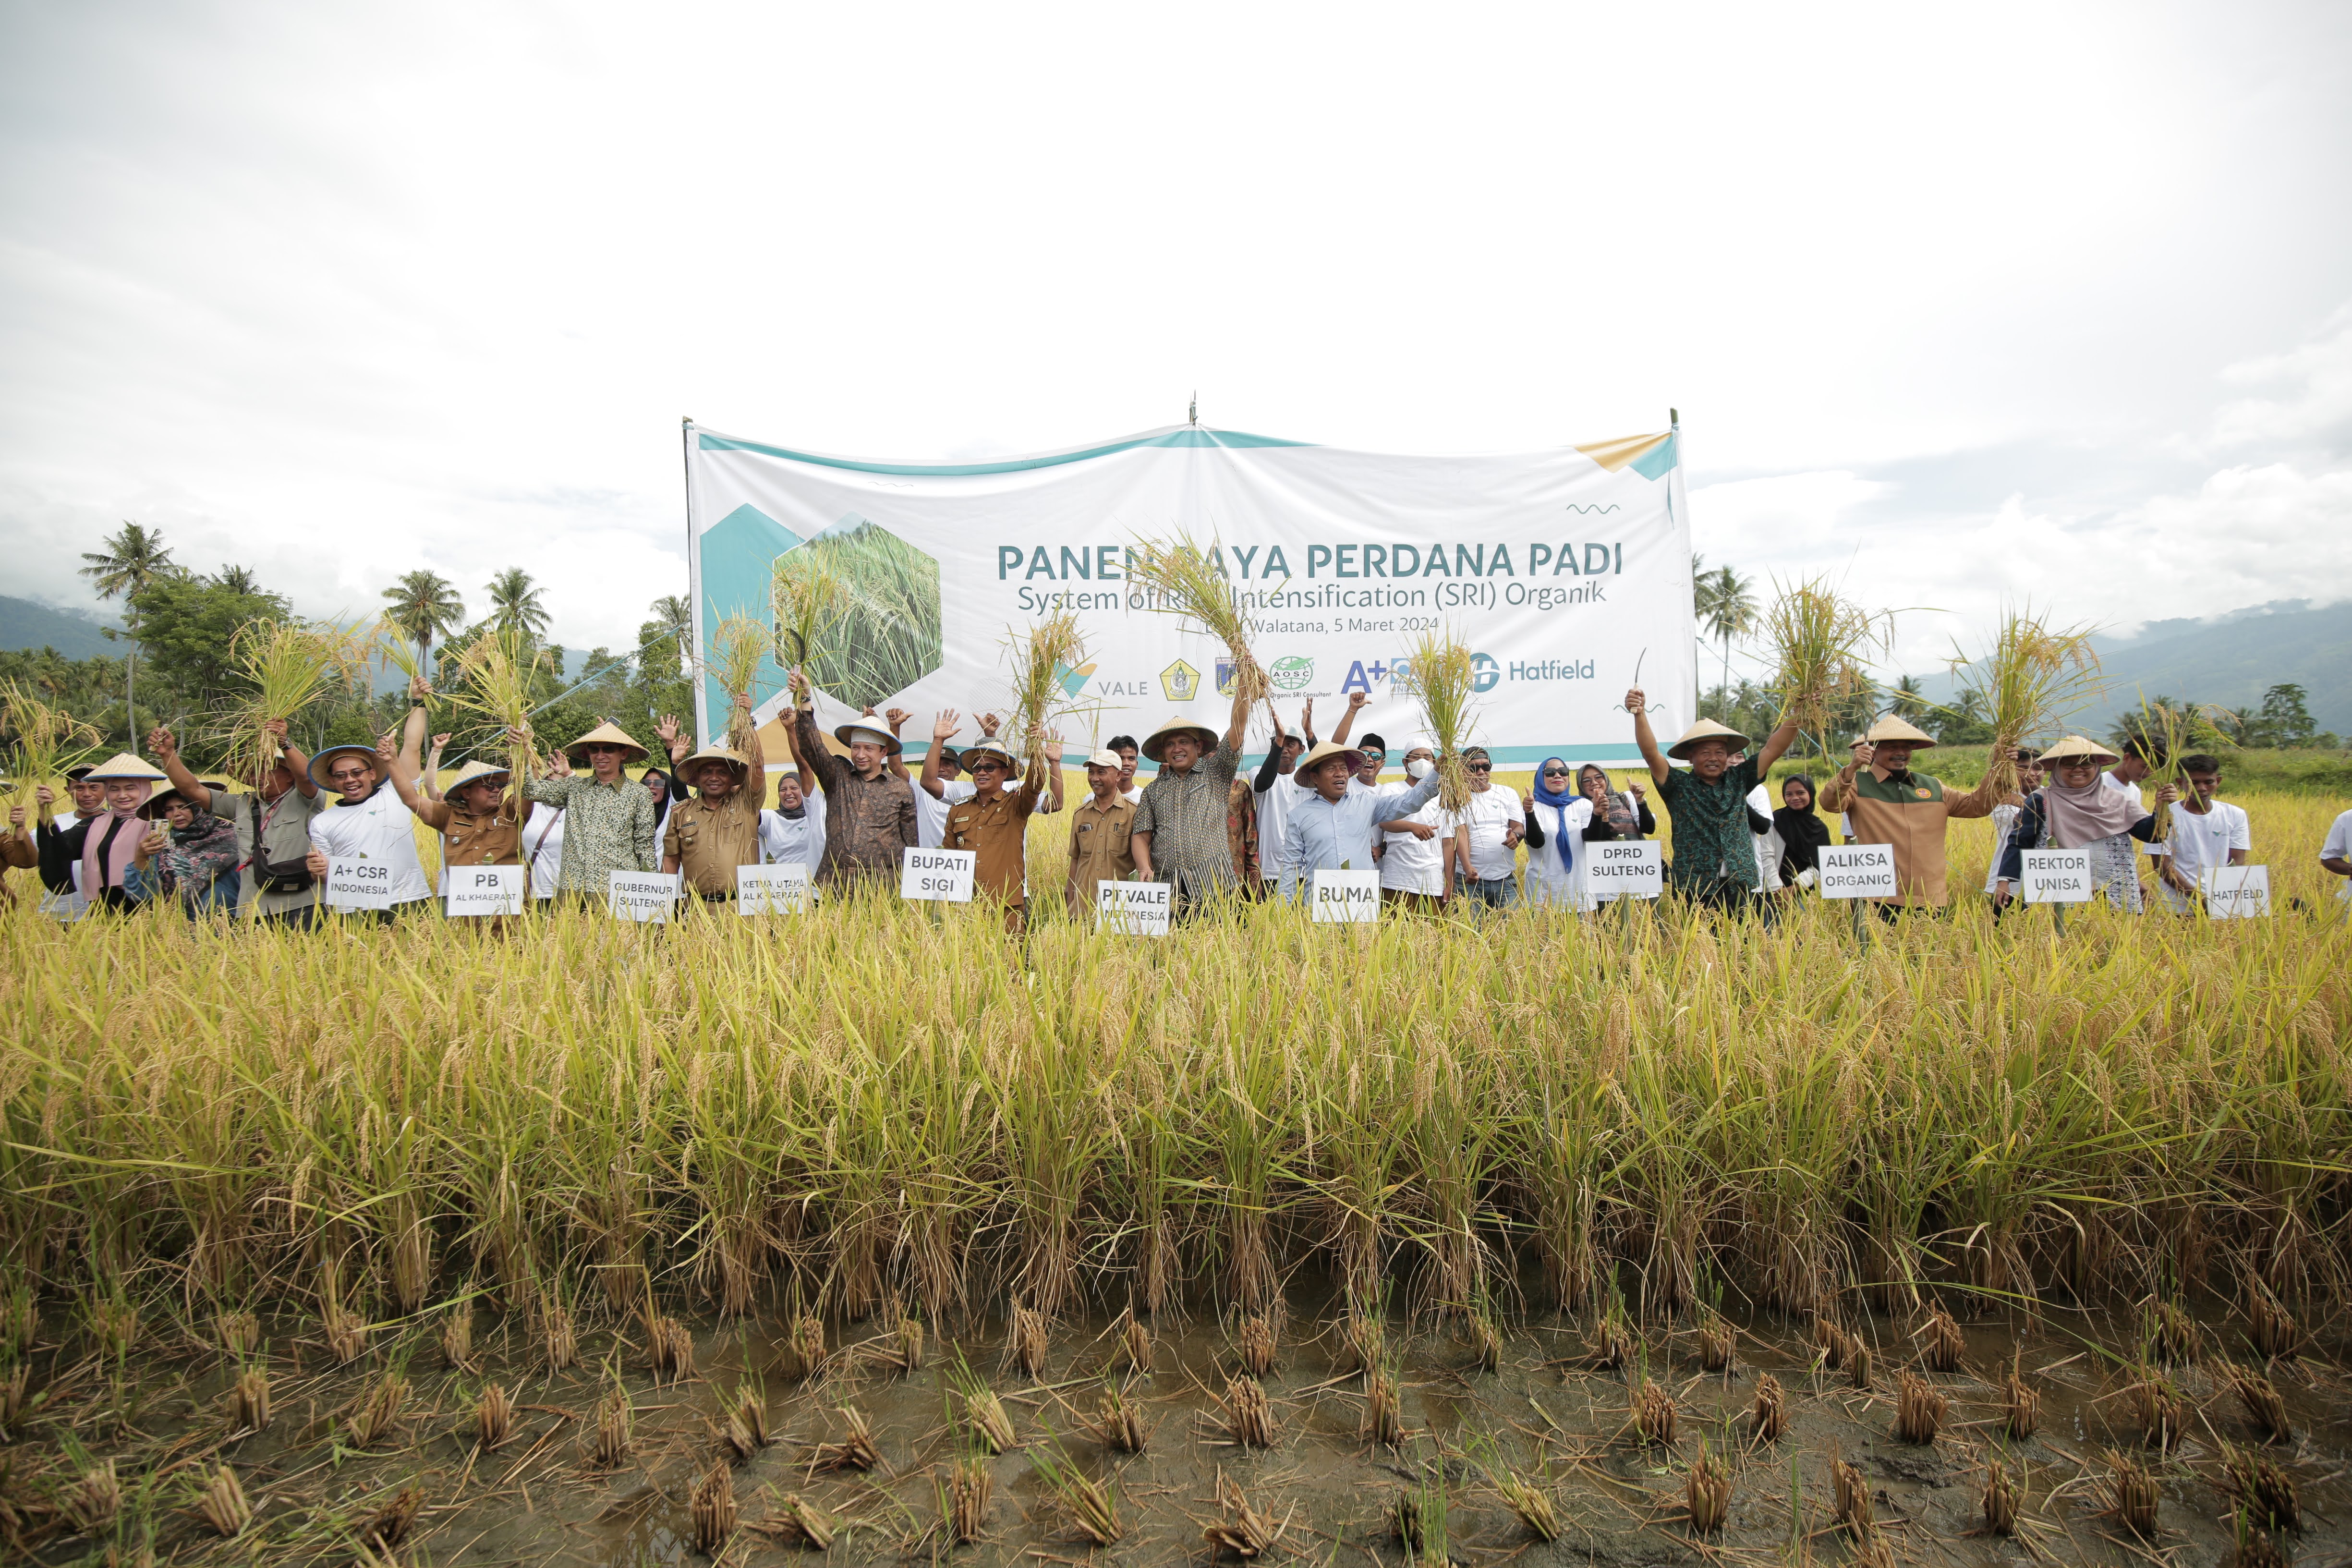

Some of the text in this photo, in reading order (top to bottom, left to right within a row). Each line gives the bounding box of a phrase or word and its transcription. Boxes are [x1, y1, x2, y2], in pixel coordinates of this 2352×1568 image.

[1173, 544, 1292, 580] AYA
[1308, 543, 1515, 578] PERDANA
[1529, 542, 1622, 576] PADI
[1018, 586, 1118, 616] System
[1128, 586, 1155, 609] of
[1233, 583, 1425, 608] Intensification
[1435, 581, 1496, 611] (SRI)
[1505, 580, 1607, 610] Organik
[1252, 619, 1328, 634] Walatana,
[1334, 618, 1343, 632] 5
[1349, 618, 1394, 632] Maret
[1399, 617, 1440, 631] 2024
[1509, 659, 1595, 681] Hatfield
[1098, 681, 1148, 695] VALE
[1604, 848, 1642, 859] DPRD
[1826, 853, 1888, 867] ALIKSA
[911, 855, 968, 871] BUPATI
[2028, 857, 2085, 870] REKTOR
[334, 864, 388, 879] A+ CSR
[1592, 865, 1656, 876] SULTENG
[475, 874, 498, 887] PB
[921, 878, 954, 892] SIGI
[1825, 874, 1891, 887] ORGANIC
[2035, 878, 2081, 890] UNISA
[331, 883, 388, 895] INDONESIA
[614, 882, 673, 895] GUBERNUR
[1319, 887, 1374, 902] BUMA
[2212, 889, 2264, 900] HATFIELD
[757, 891, 802, 900] KAERAA
[1103, 888, 1166, 904] PT VALE
[619, 897, 666, 908] SULTENG
